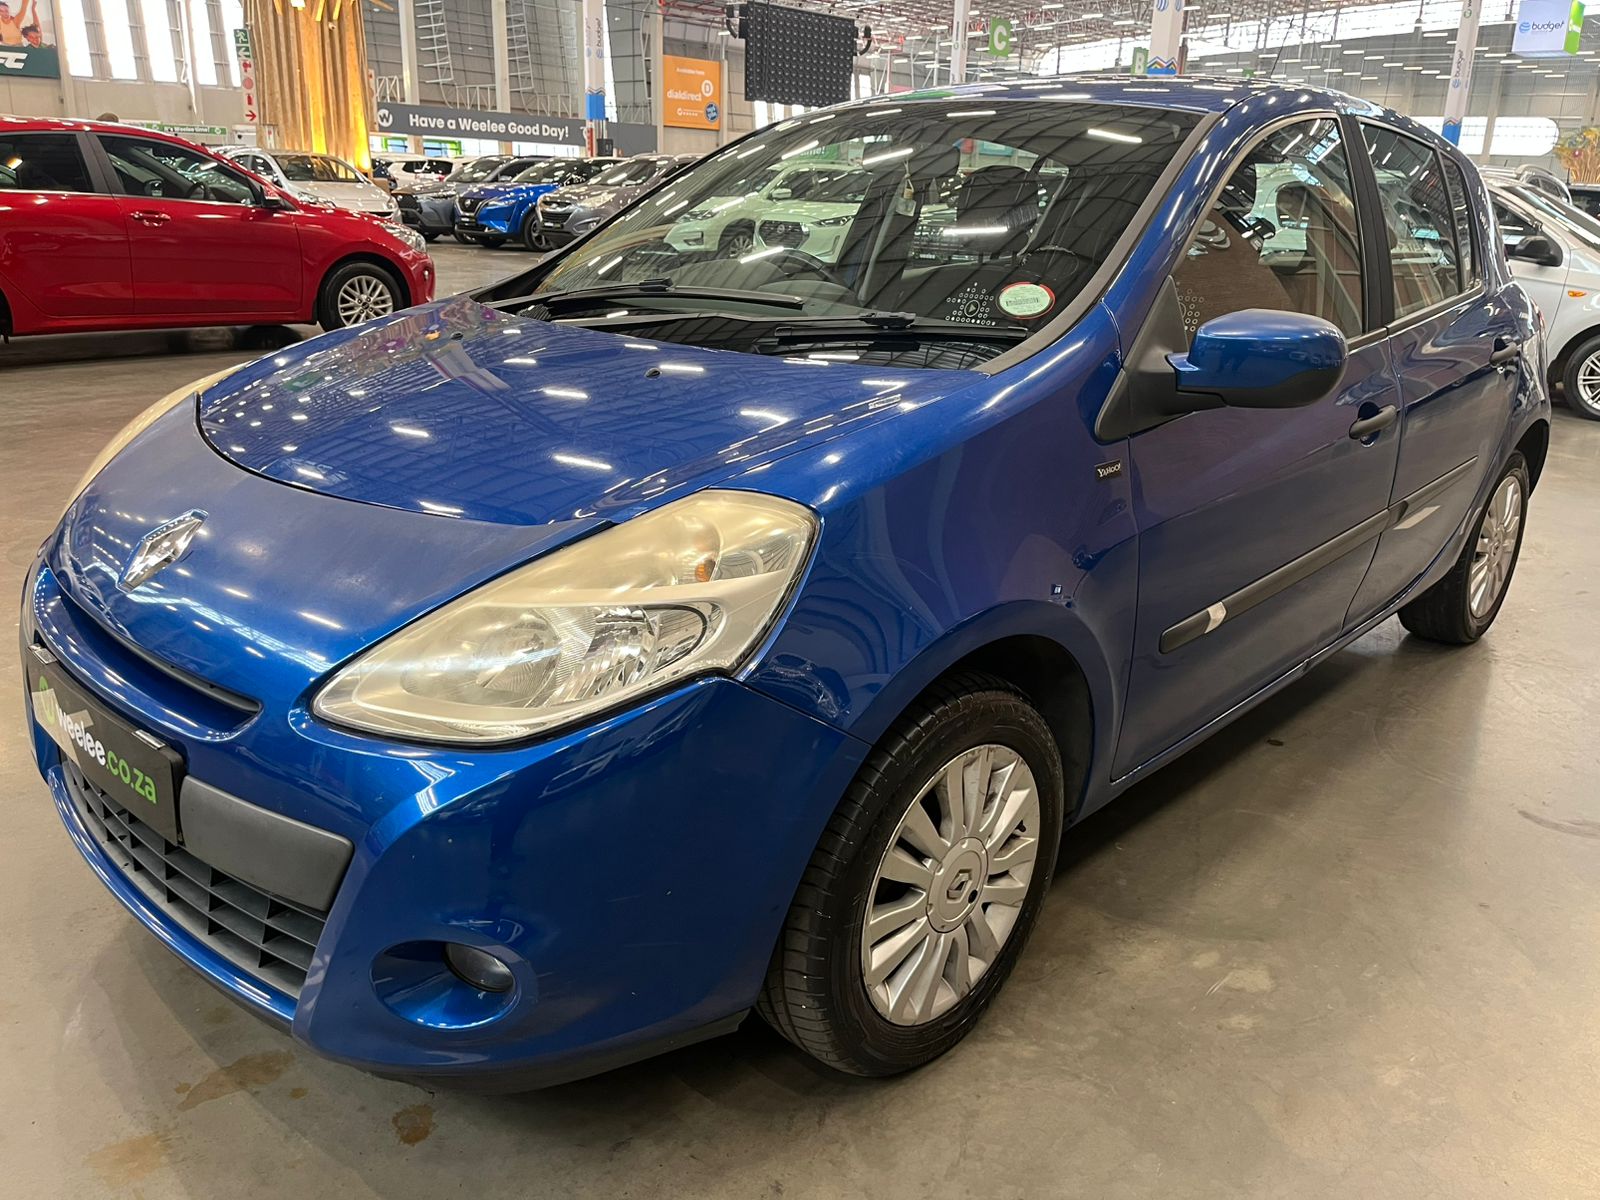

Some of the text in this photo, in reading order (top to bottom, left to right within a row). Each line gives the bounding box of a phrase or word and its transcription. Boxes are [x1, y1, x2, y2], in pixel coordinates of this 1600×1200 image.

[1532, 20, 1565, 33] budget
[993, 25, 1007, 50] C
[666, 89, 702, 102] dialdirect
[409, 113, 569, 141] Have a Weelee Good Day!
